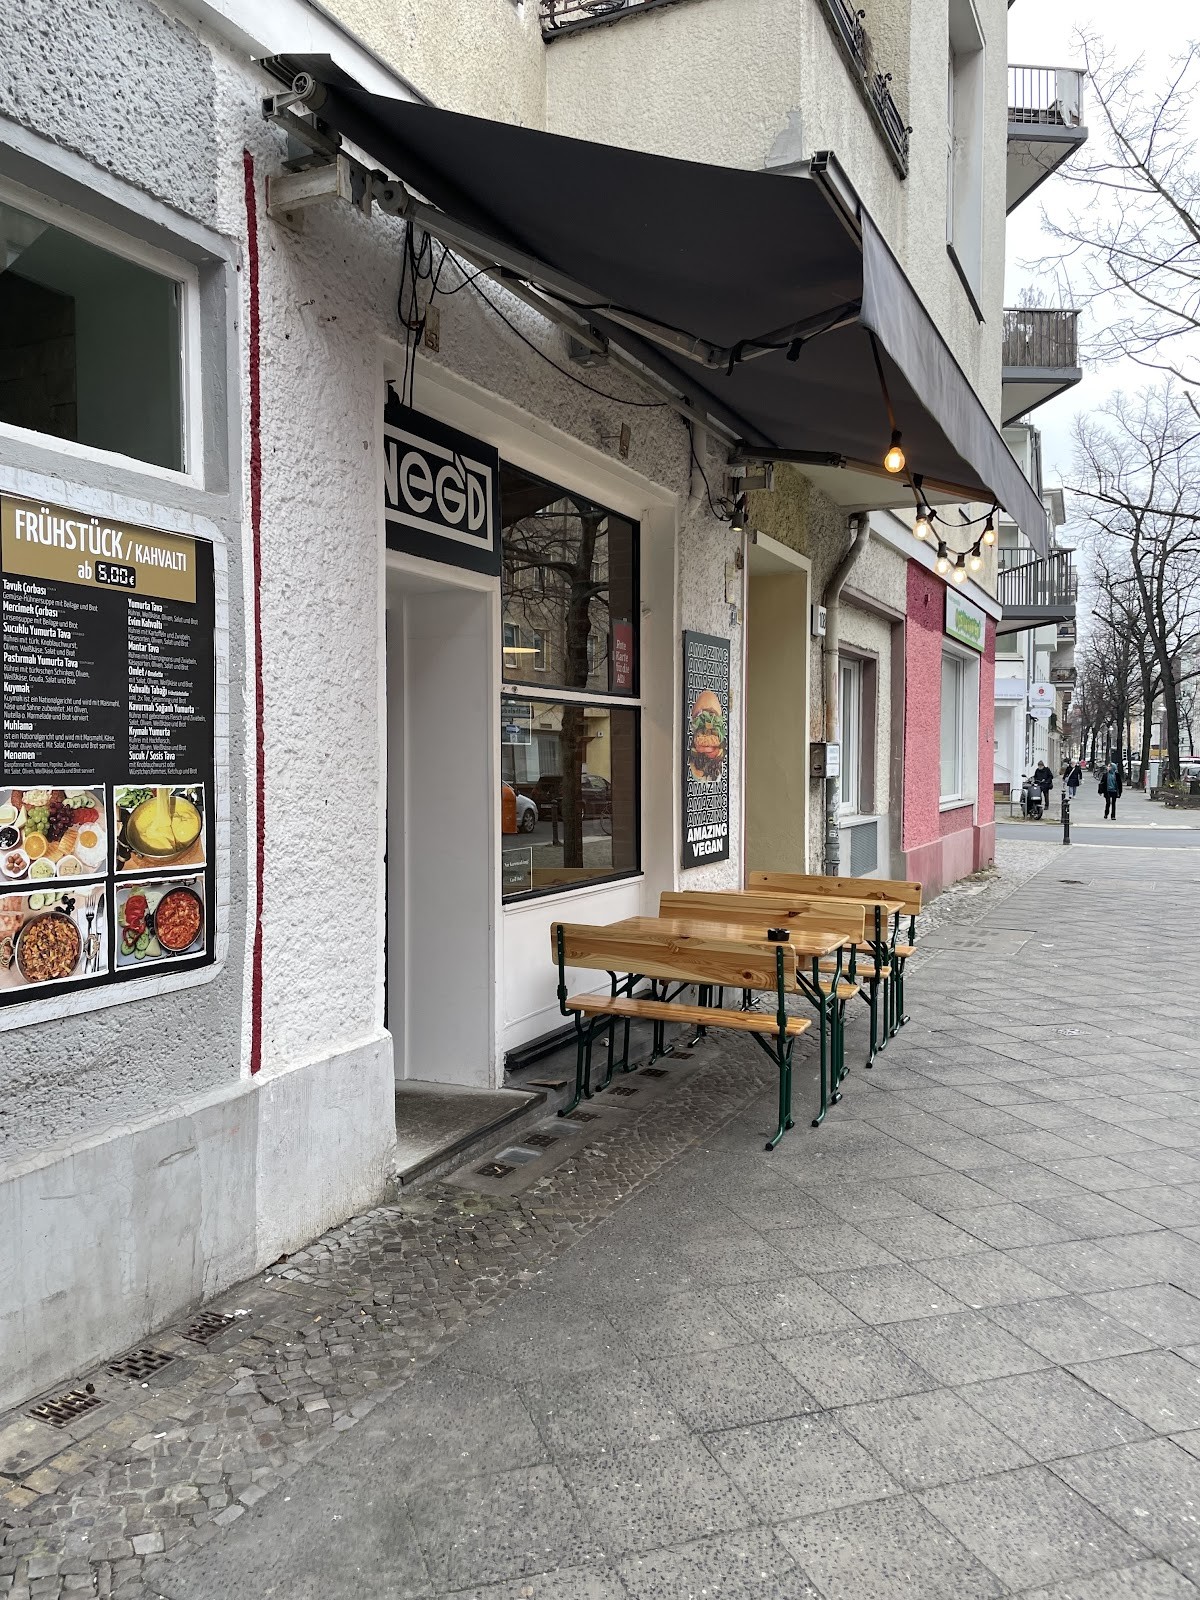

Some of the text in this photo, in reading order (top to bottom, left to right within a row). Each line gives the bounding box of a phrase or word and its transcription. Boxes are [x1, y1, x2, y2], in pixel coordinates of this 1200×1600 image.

[15, 506, 123, 559] FRÜHSTÜCK
[135, 543, 187, 572] KAHVALTI
[77, 560, 92, 580] ab
[3, 579, 46, 595] Tavuk Çorbası
[3, 601, 58, 617] Mercimek Çorbası
[128, 598, 162, 612] Yumurta Tava
[3, 622, 71, 639] Sucuklu Yumurta Tava
[128, 641, 159, 653] Mantar Tava
[38, 655, 63, 667] Yumurta
[64, 658, 78, 668] Tava
[4, 682, 30, 694] Kuymak
[4, 720, 33, 730] Muhlama
[4, 750, 35, 759] Menemen
[687, 823, 728, 843] AMAZING
[692, 838, 723, 857] VEGAN
